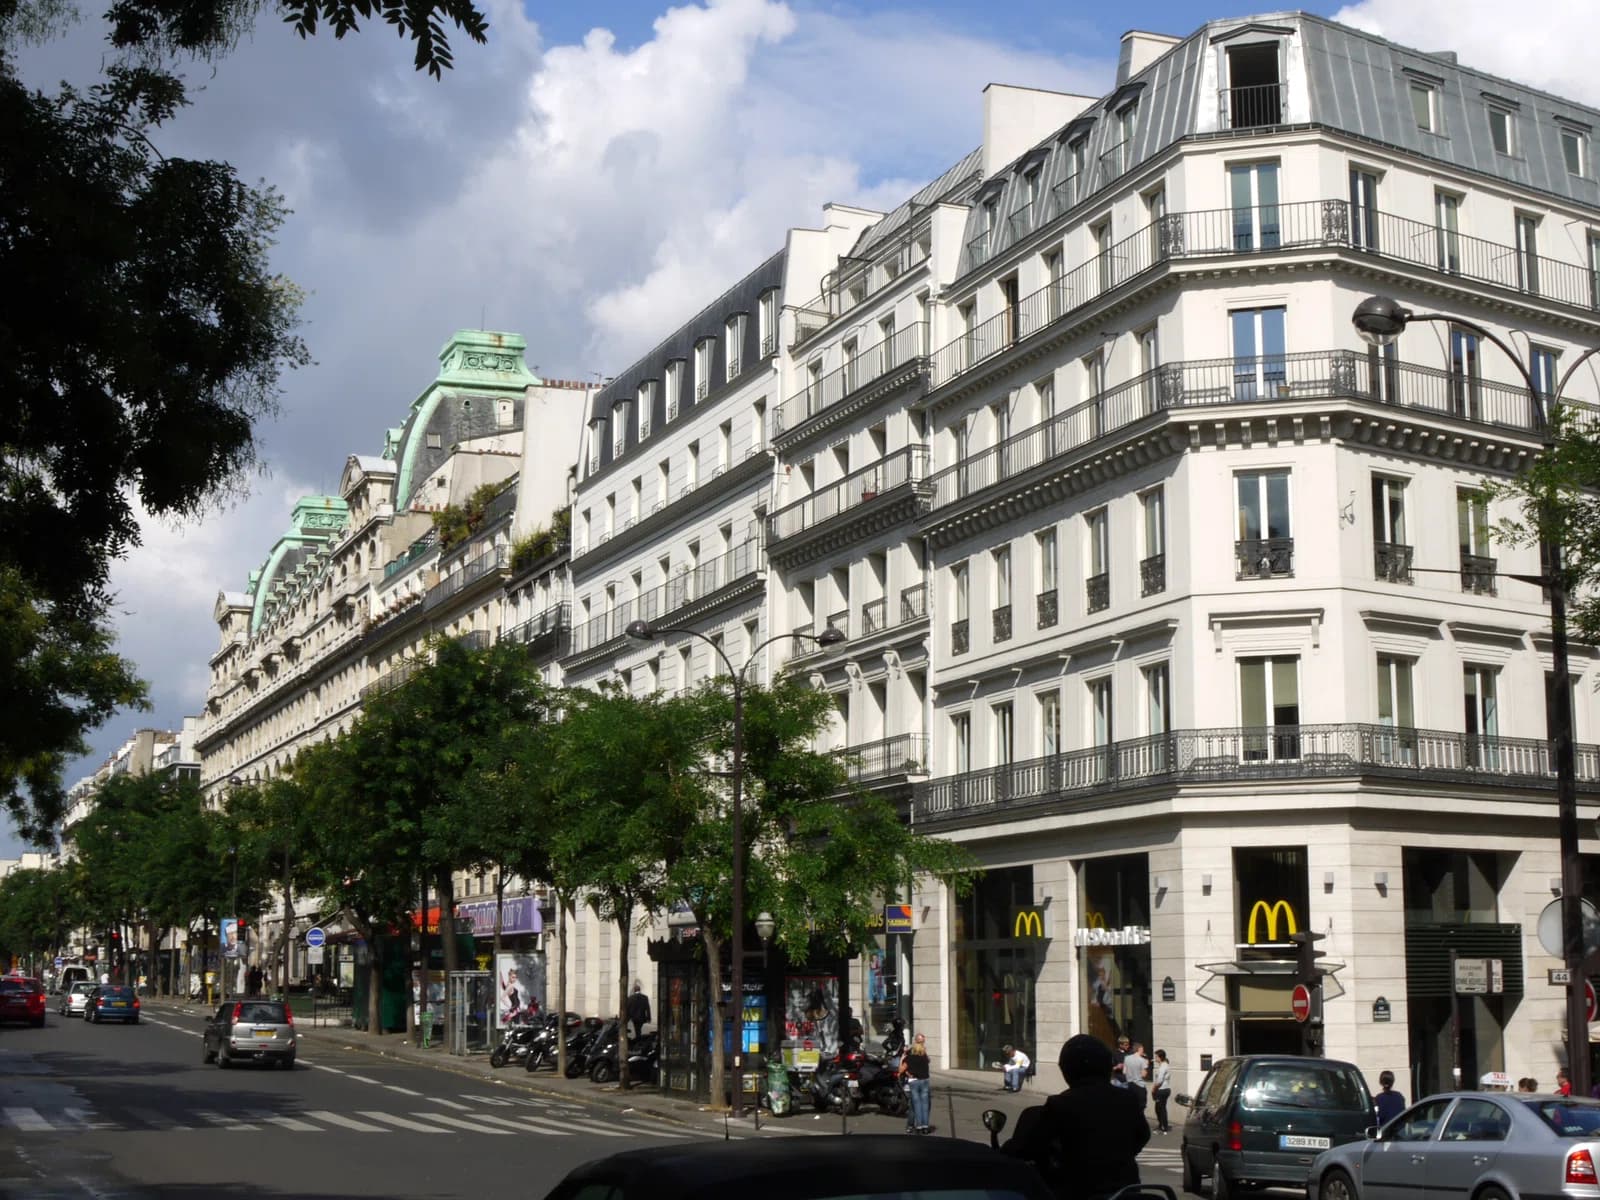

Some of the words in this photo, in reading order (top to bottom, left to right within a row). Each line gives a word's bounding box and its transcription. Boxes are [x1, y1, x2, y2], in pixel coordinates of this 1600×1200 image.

[1075, 925, 1151, 947] McDonald's
[1554, 973, 1568, 981] 44
[1492, 1072, 1508, 1080] TAXI
